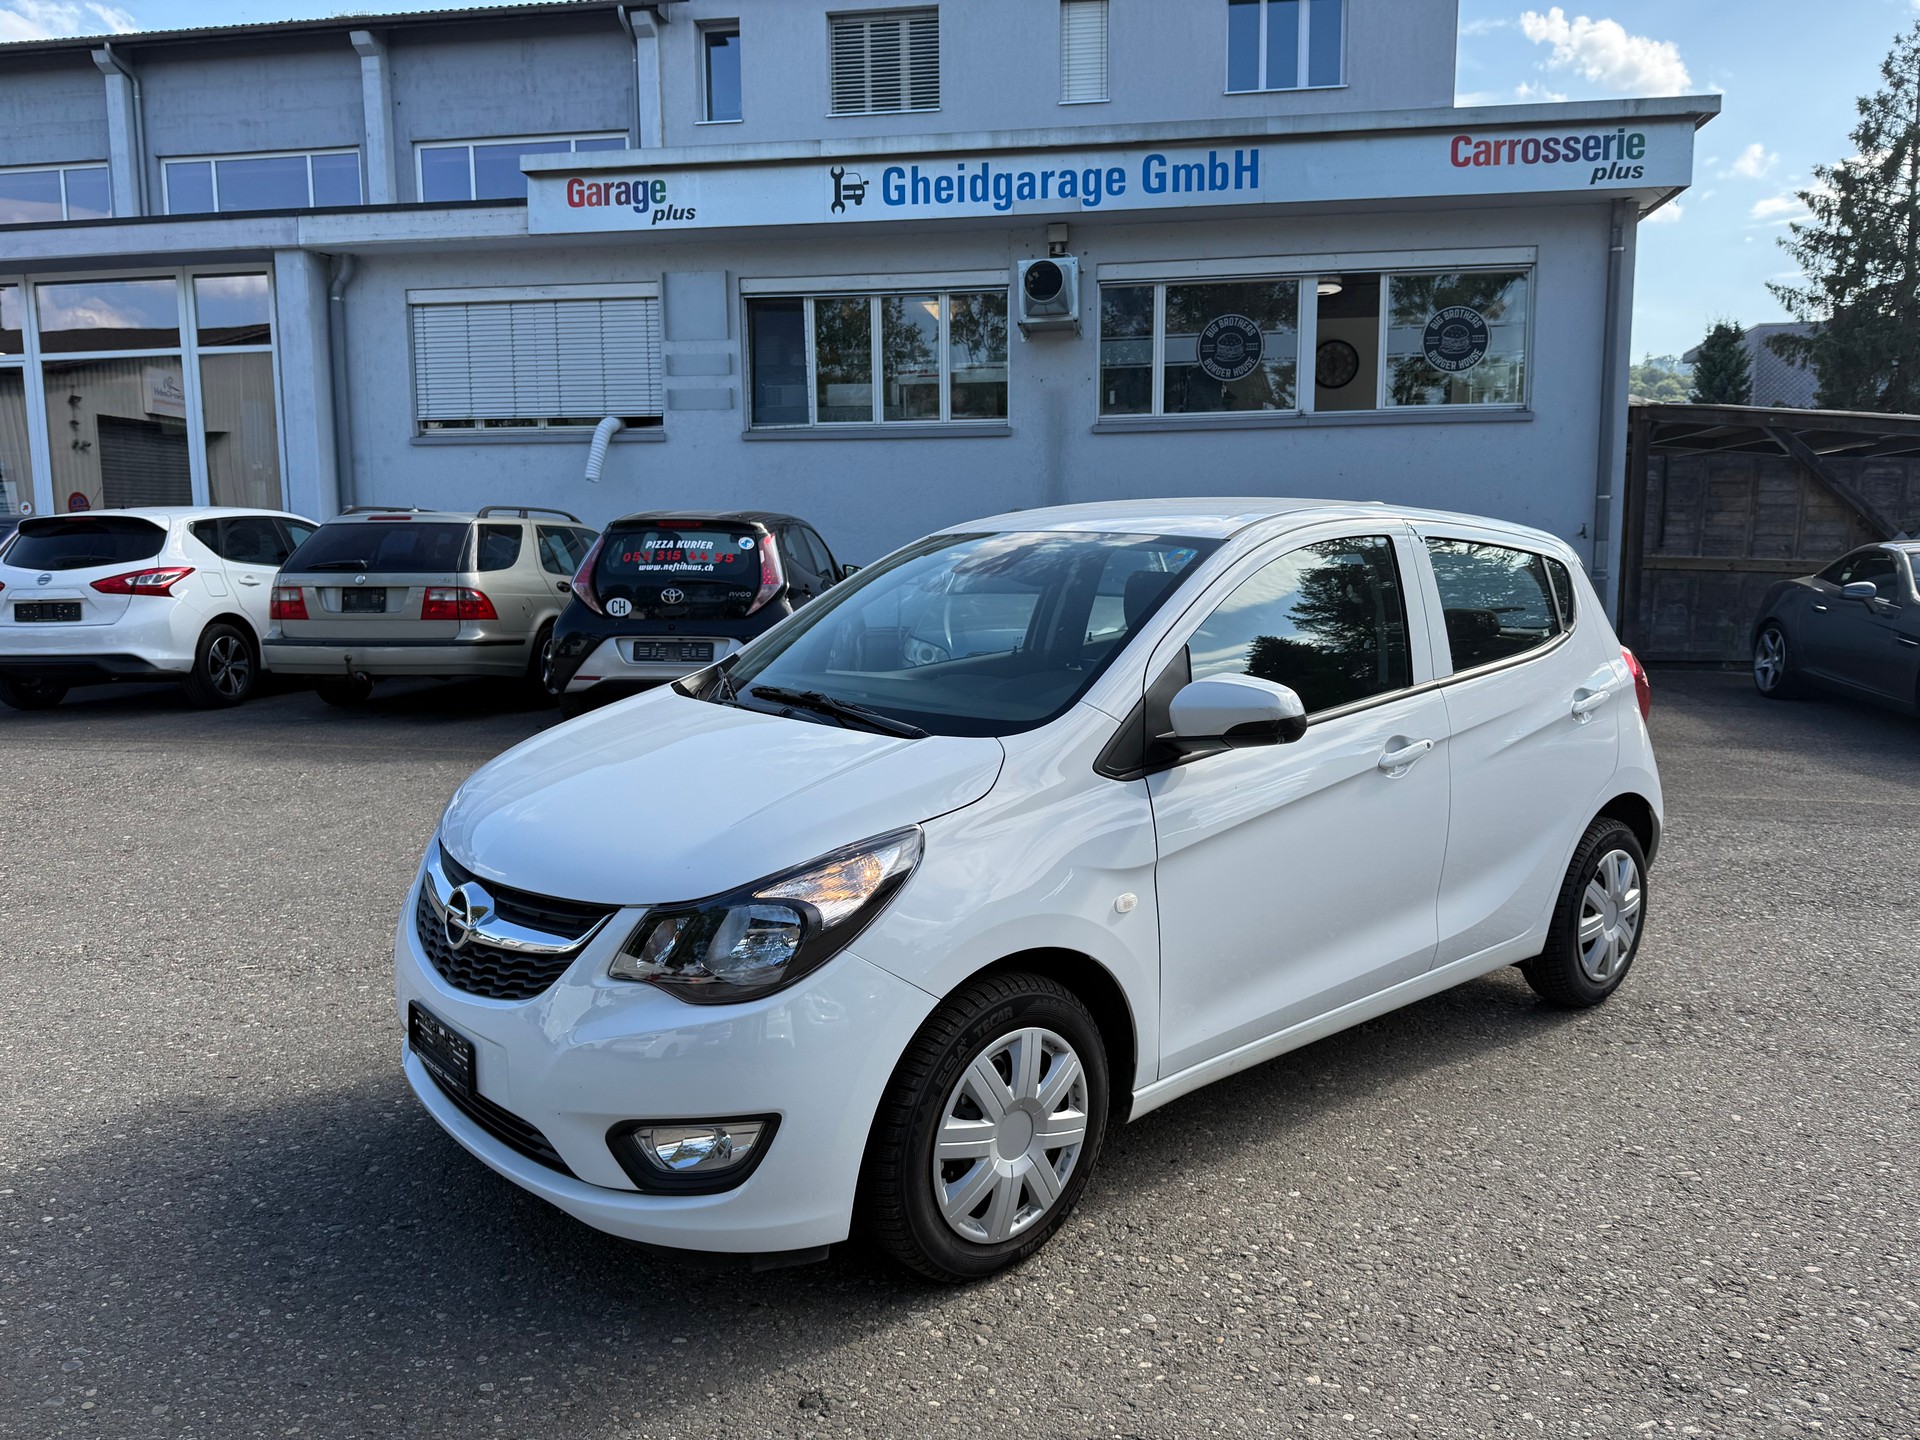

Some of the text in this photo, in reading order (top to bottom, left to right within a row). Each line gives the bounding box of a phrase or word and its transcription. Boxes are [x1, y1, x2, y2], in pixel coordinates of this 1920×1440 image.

[1450, 128, 1645, 168] Carrosserie
[882, 149, 1259, 211] Gheidgarage GmbH
[1589, 162, 1645, 185] plus
[566, 178, 667, 213] Garage
[651, 204, 697, 225] plus
[1205, 317, 1256, 338] BIG BROTHERS
[1430, 309, 1483, 330] BIG BROTHERS
[1203, 356, 1256, 378] BURGER HOUSE
[1428, 348, 1483, 370] BURGER HOUSE
[645, 540, 714, 550] PIZZA KURIER
[656, 550, 682, 561] 315
[688, 551, 708, 561] 44
[714, 552, 735, 563] 55
[611, 600, 626, 614] CH
[973, 1006, 1014, 1036] TECAR
